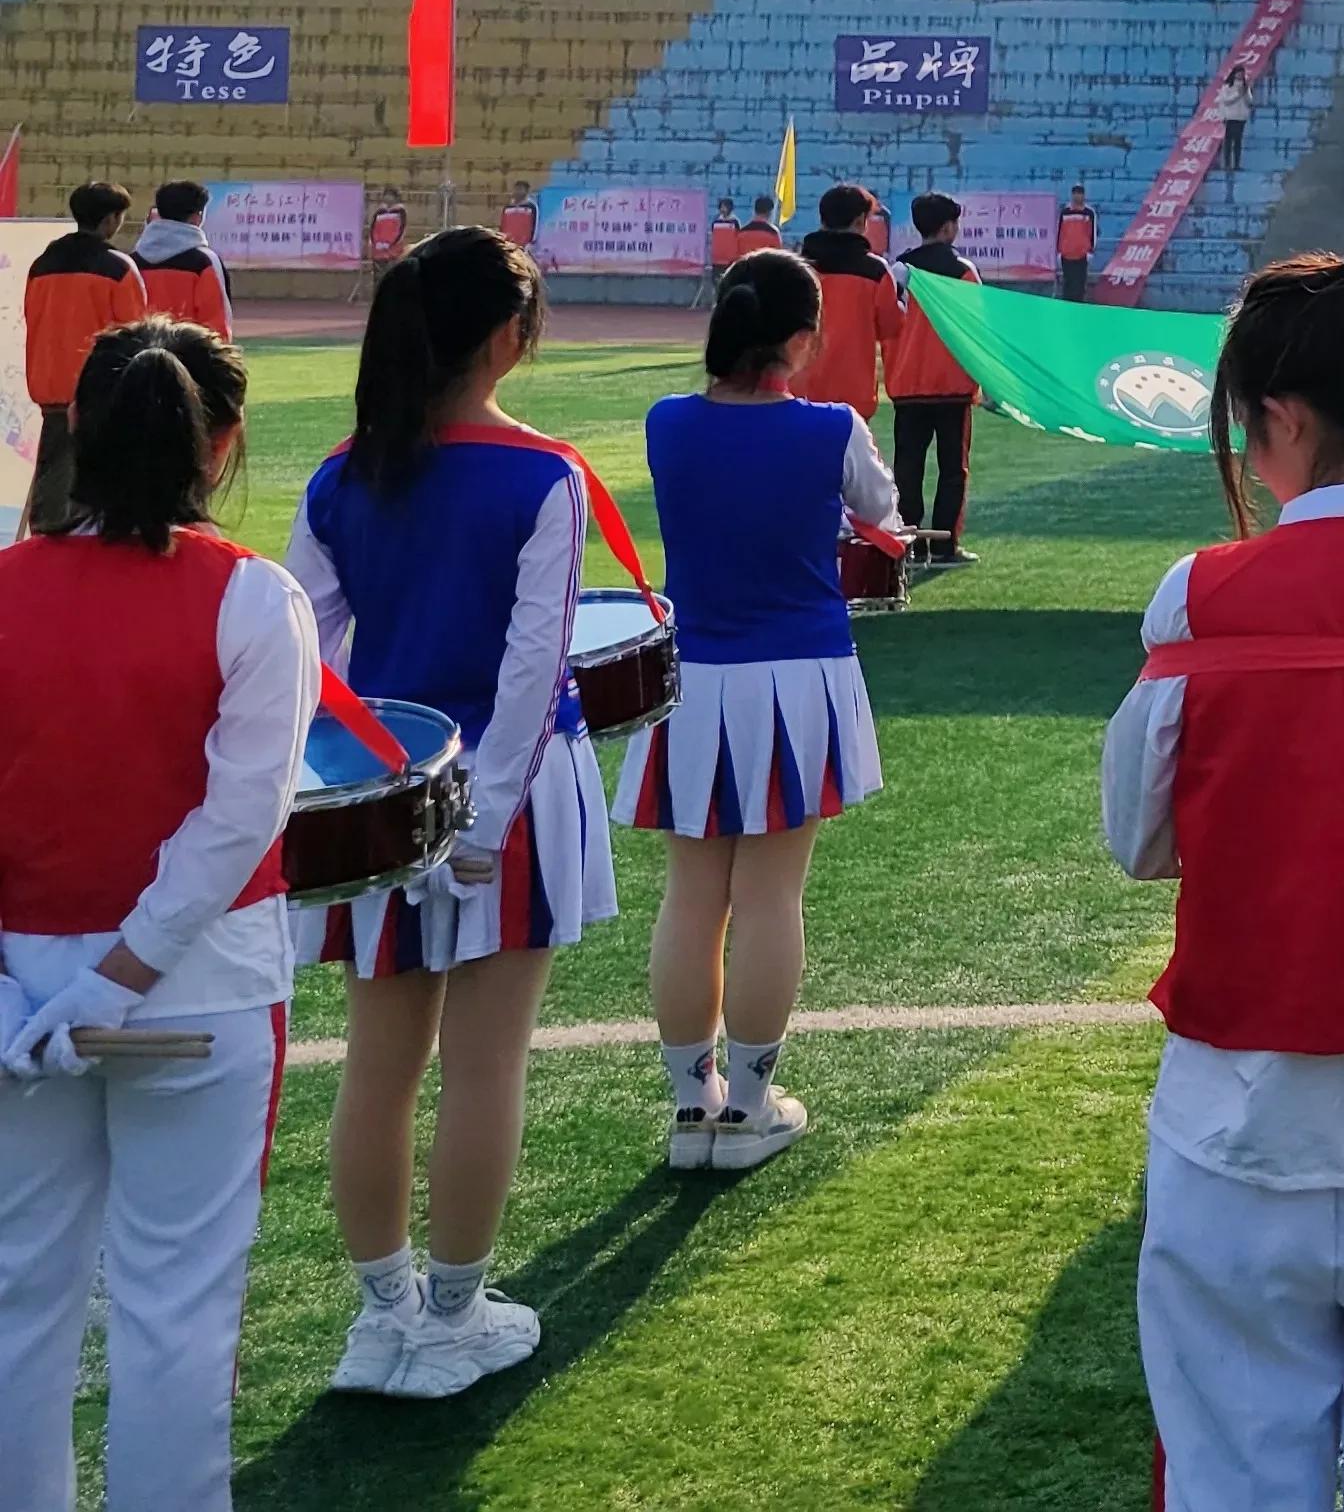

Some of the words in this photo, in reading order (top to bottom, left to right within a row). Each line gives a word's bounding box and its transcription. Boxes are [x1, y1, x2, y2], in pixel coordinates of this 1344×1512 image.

[145, 31, 276, 80] 特色
[849, 40, 981, 88] 品牌
[177, 80, 247, 100] Tese
[862, 89, 962, 110] Pinpai
